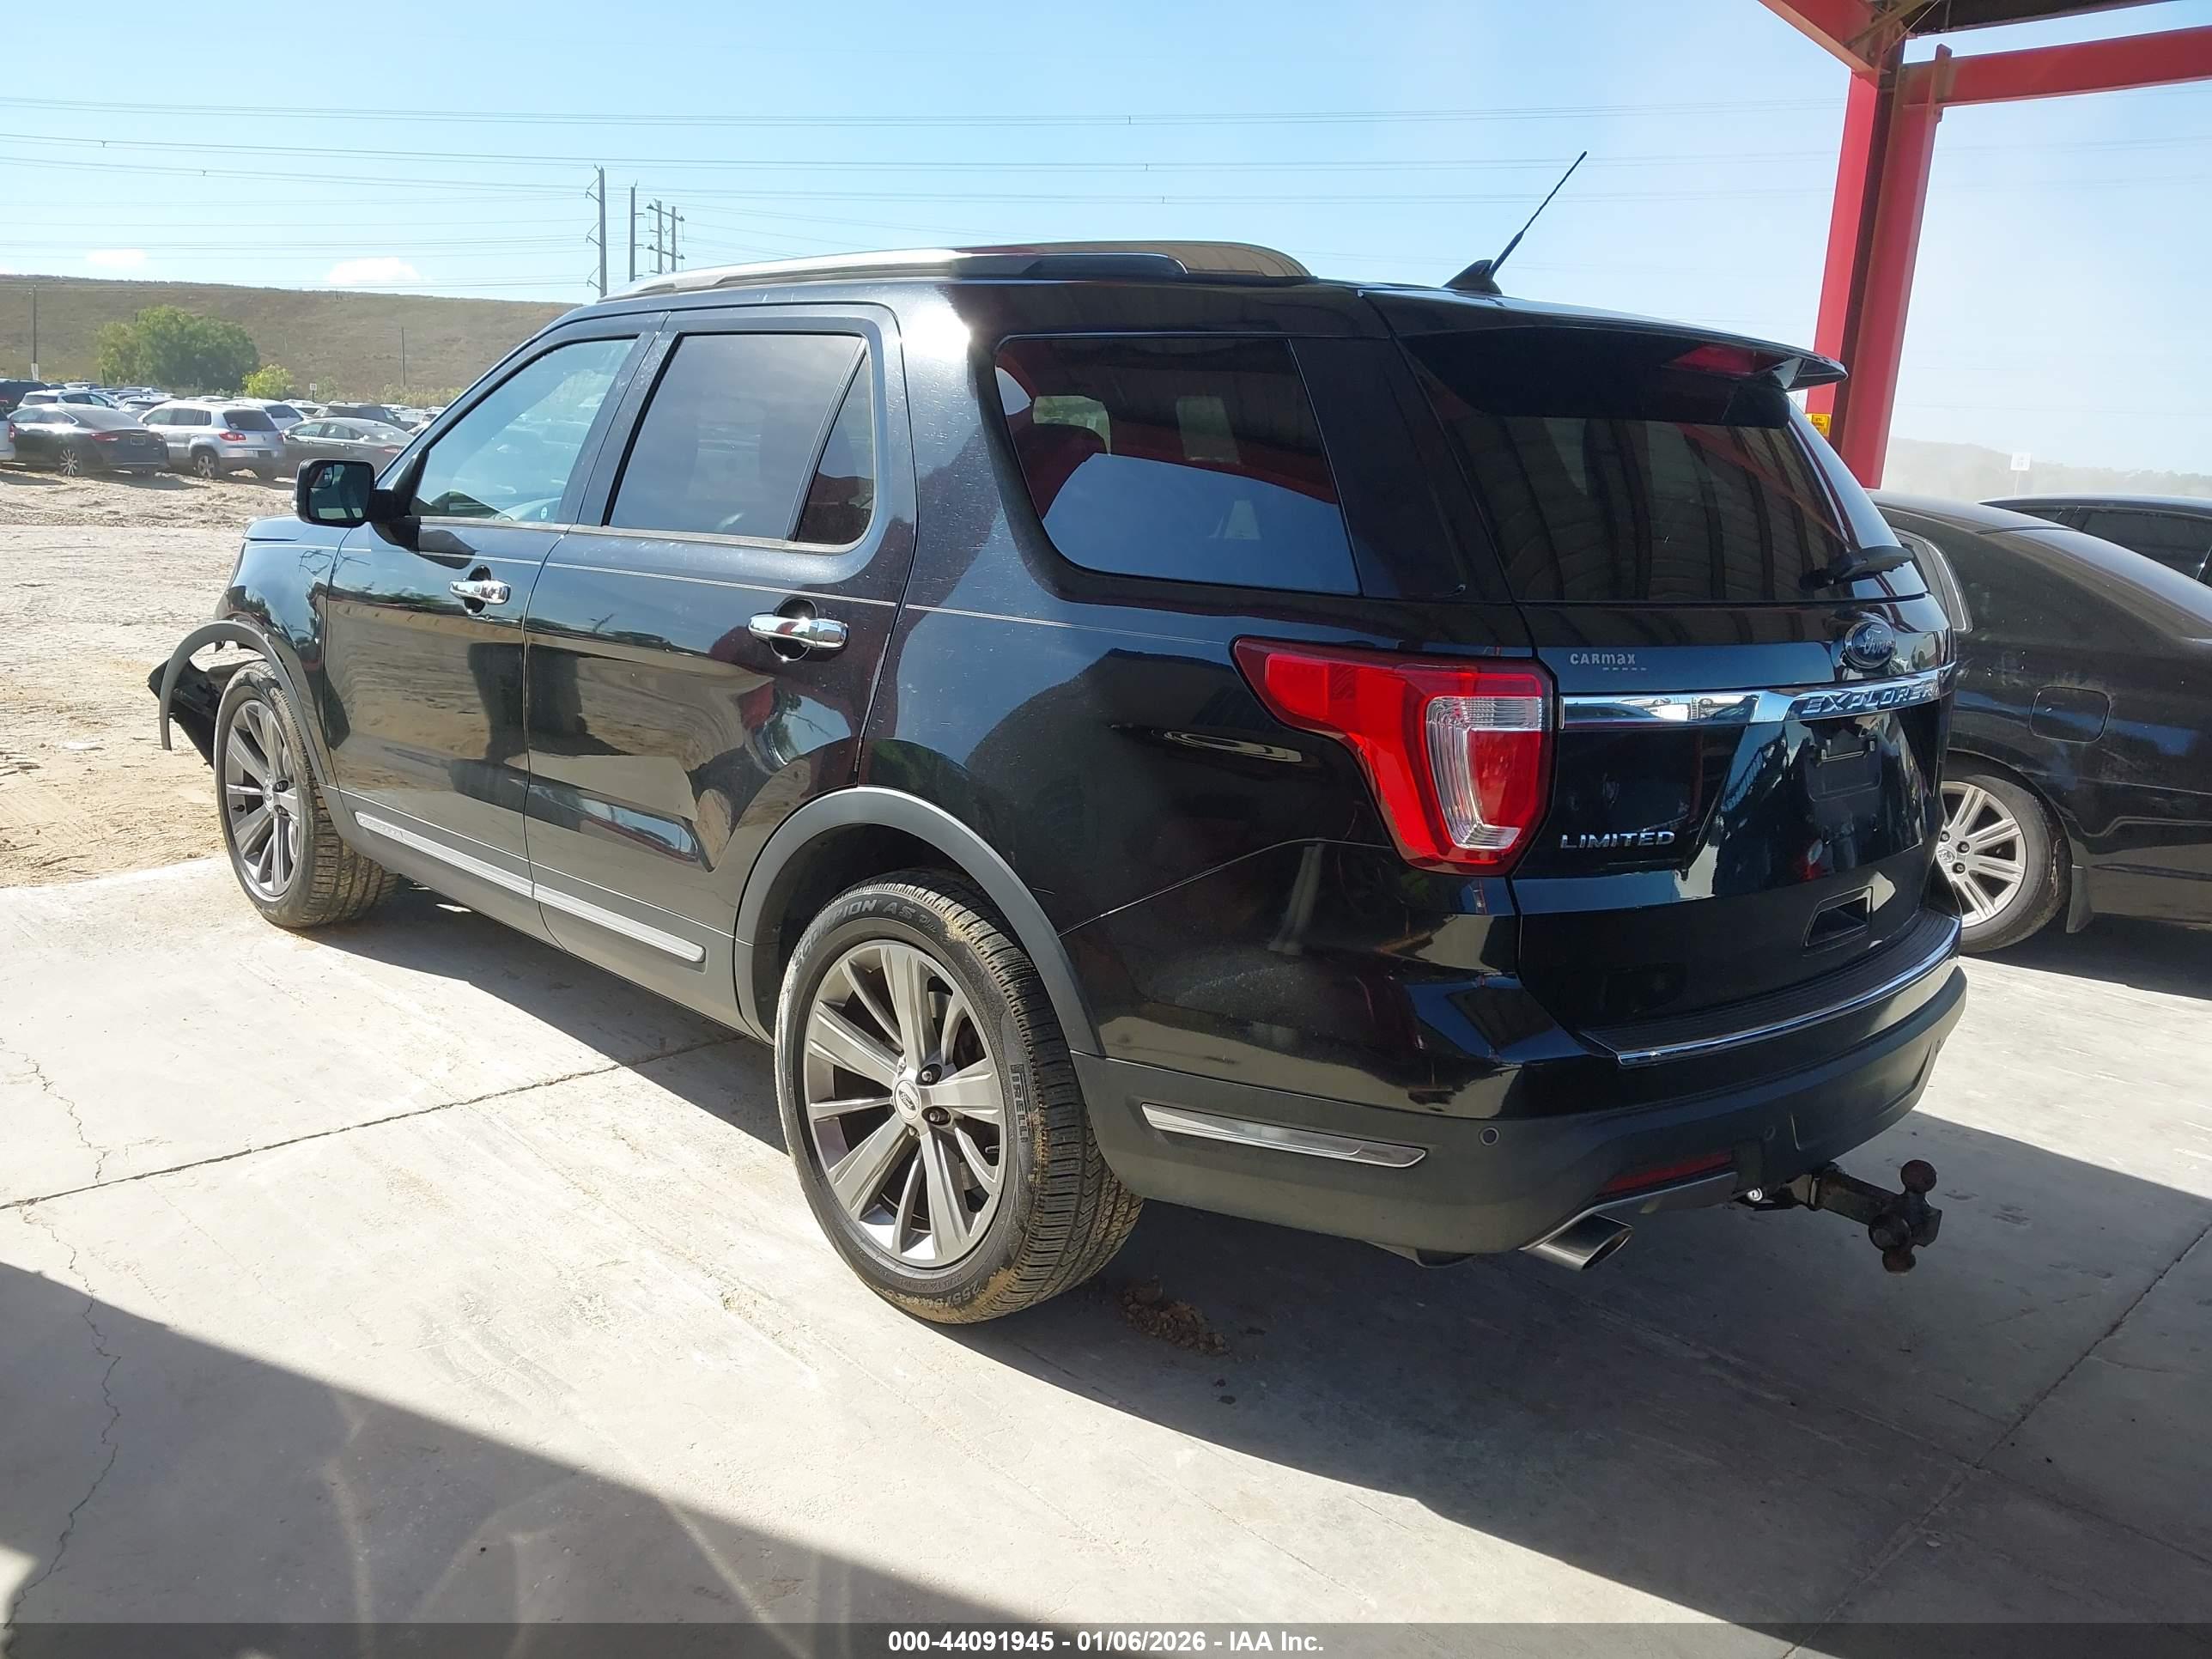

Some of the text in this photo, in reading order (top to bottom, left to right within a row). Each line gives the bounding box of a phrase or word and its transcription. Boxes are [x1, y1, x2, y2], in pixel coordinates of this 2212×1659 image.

[1801, 680, 1941, 715] EXPLORER
[1559, 830, 1675, 849] LIMITED
[882, 901, 916, 921] AS
[1009, 1064, 1030, 1144] PIRELLI
